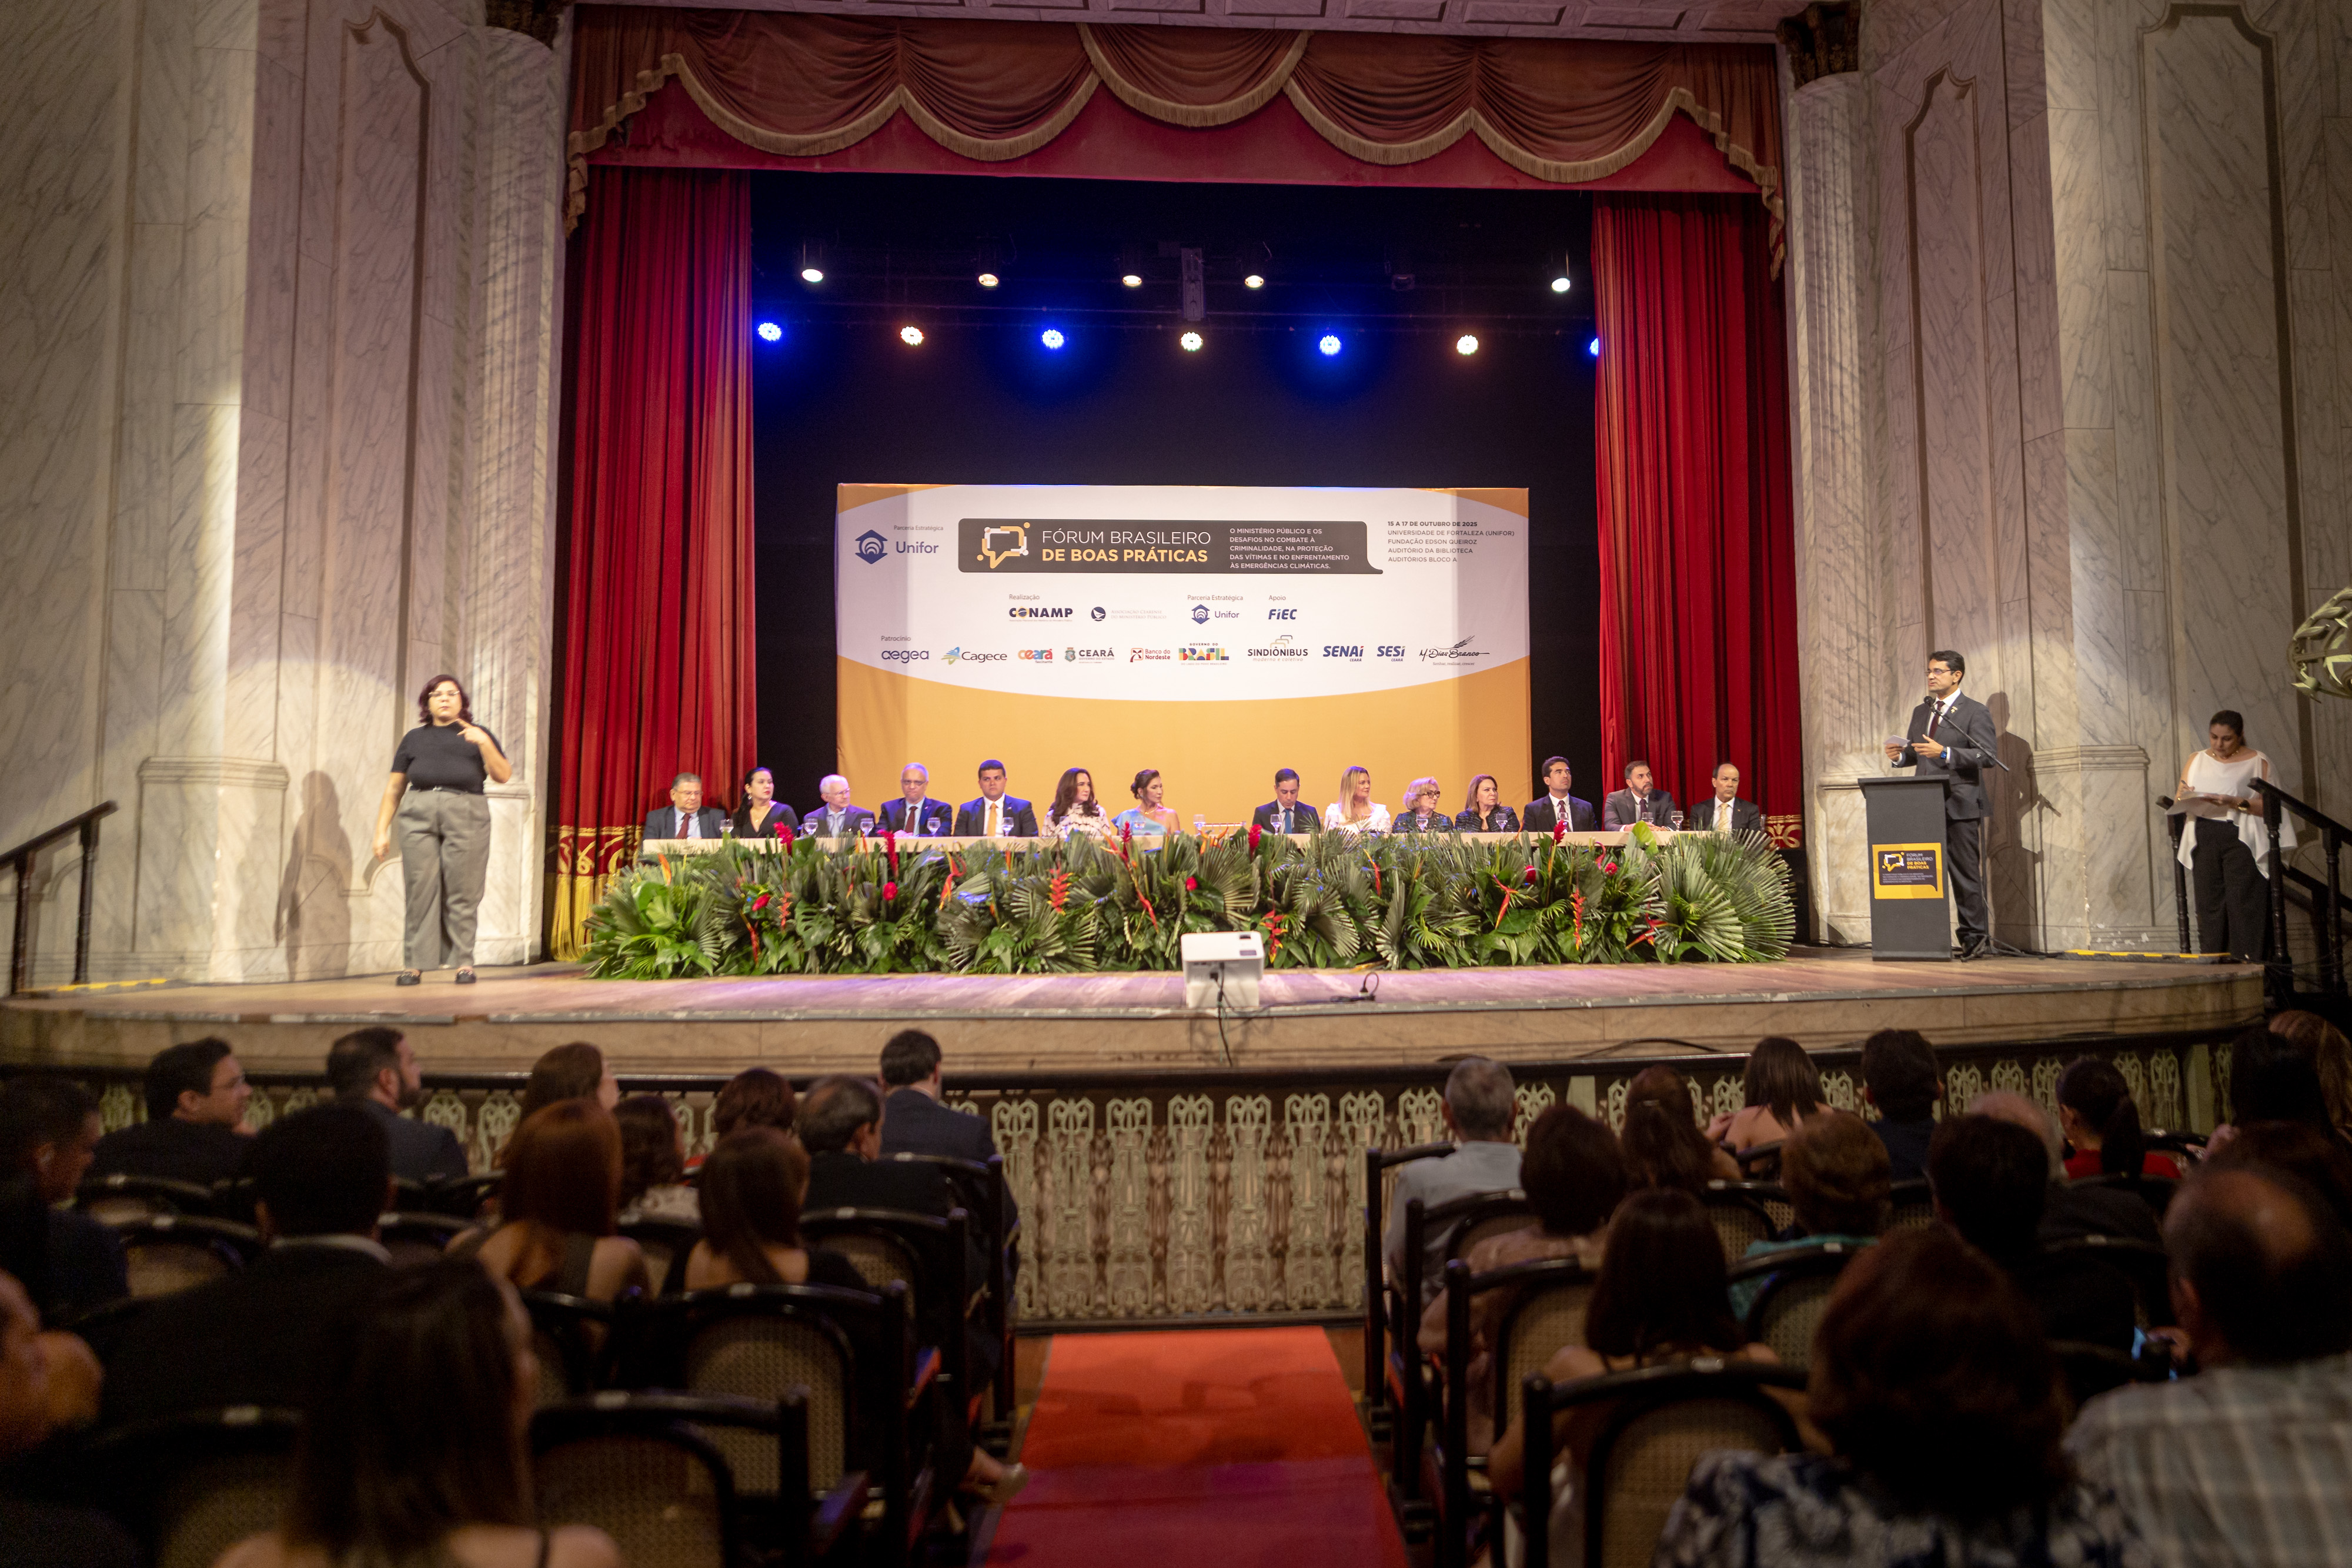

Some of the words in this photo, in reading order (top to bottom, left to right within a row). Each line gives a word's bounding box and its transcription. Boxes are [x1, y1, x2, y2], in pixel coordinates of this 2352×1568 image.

[1043, 528, 1104, 543] FÓRUM
[1111, 531, 1211, 544] BRASILEIRO
[896, 541, 939, 553] Unifor
[1042, 549, 1065, 561] DE
[1071, 549, 1118, 561] BOAS
[1124, 546, 1208, 562] PRÁTICAS
[1009, 608, 1073, 618] CONAMP
[961, 651, 1007, 663] Cagece
[1018, 648, 1053, 660] ceará
[1079, 647, 1114, 657] CEARÁ
[1178, 648, 1229, 660] BRASIL
[1248, 647, 1308, 656] SINDIÔNIBUS
